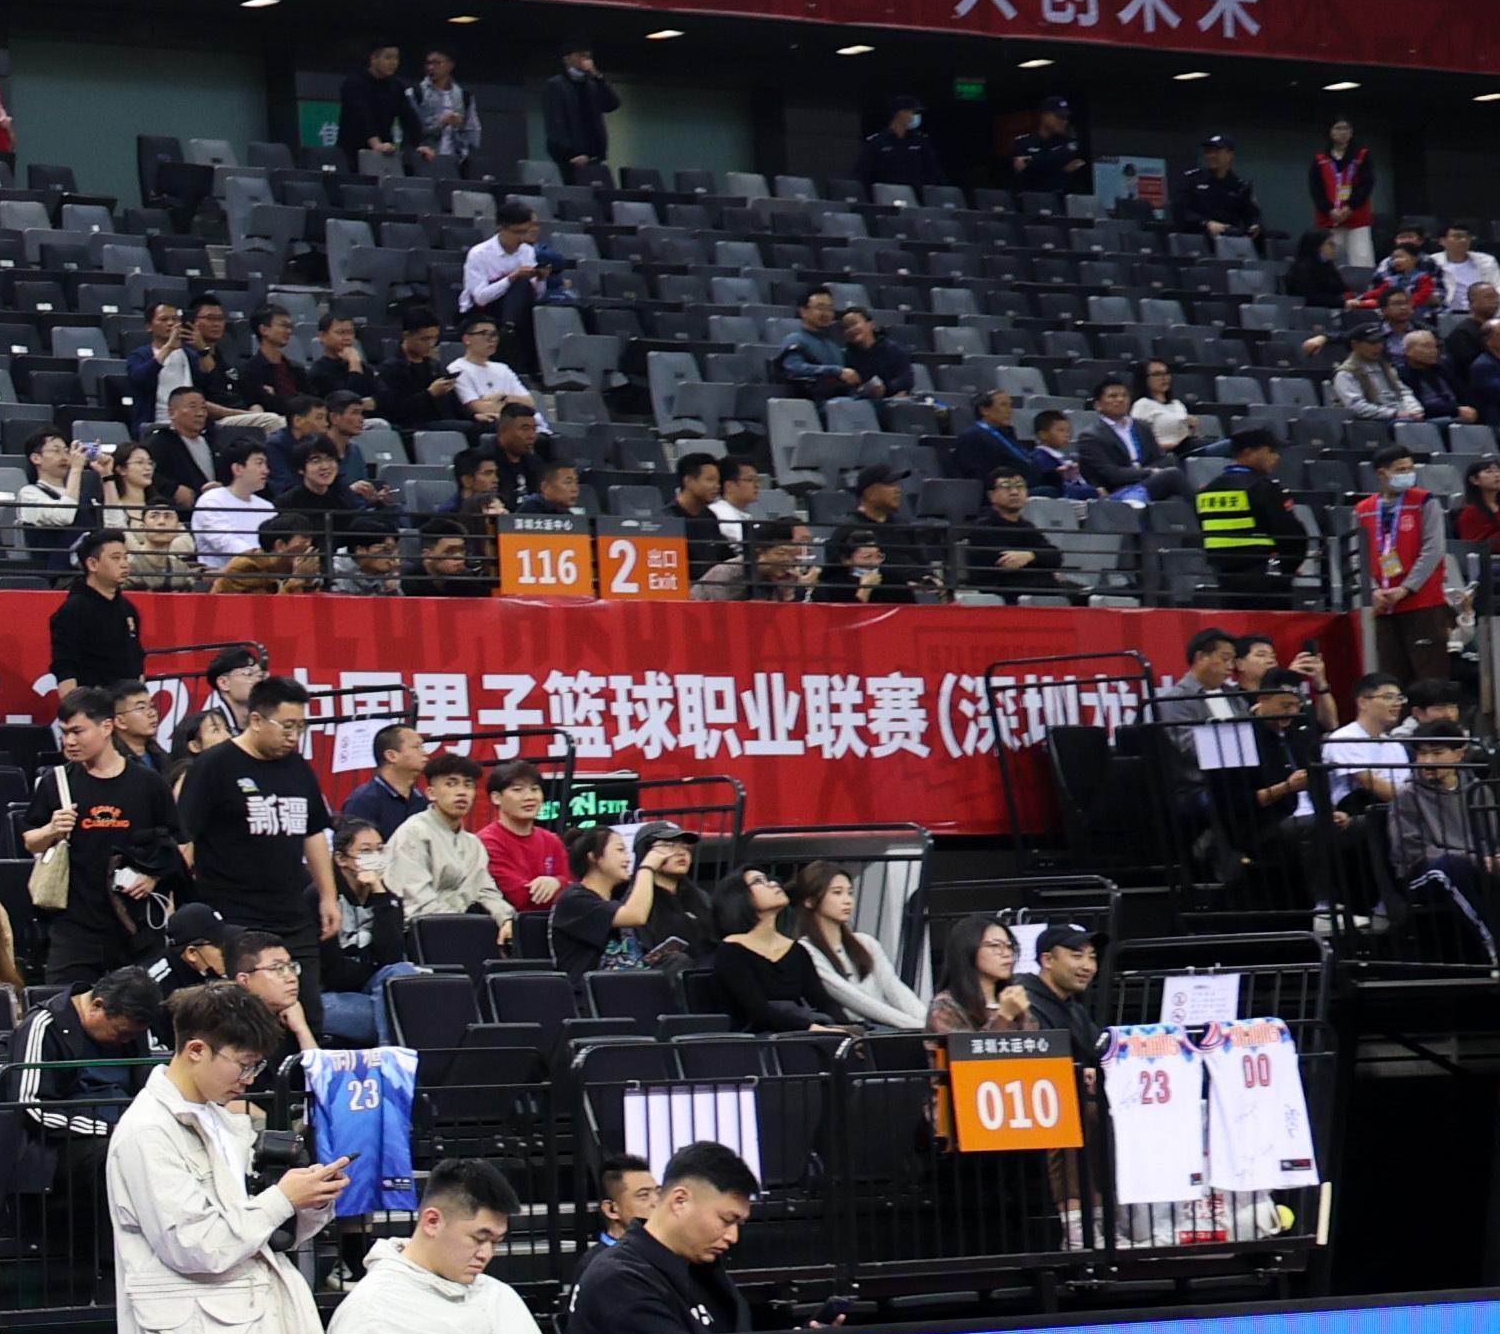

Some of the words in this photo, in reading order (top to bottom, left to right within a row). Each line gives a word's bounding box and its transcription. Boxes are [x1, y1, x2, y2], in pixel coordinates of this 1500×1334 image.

[517, 549, 578, 585] 116
[608, 539, 639, 594] 2
[647, 548, 678, 569] 出口
[647, 572, 679, 590] Exit
[246, 794, 309, 836] 新疆
[971, 1037, 1050, 1054] 深圳大运中心
[1139, 1069, 1171, 1105] 23
[1243, 1053, 1270, 1088] 00
[347, 1078, 380, 1111] 23
[975, 1078, 1060, 1131] 010
